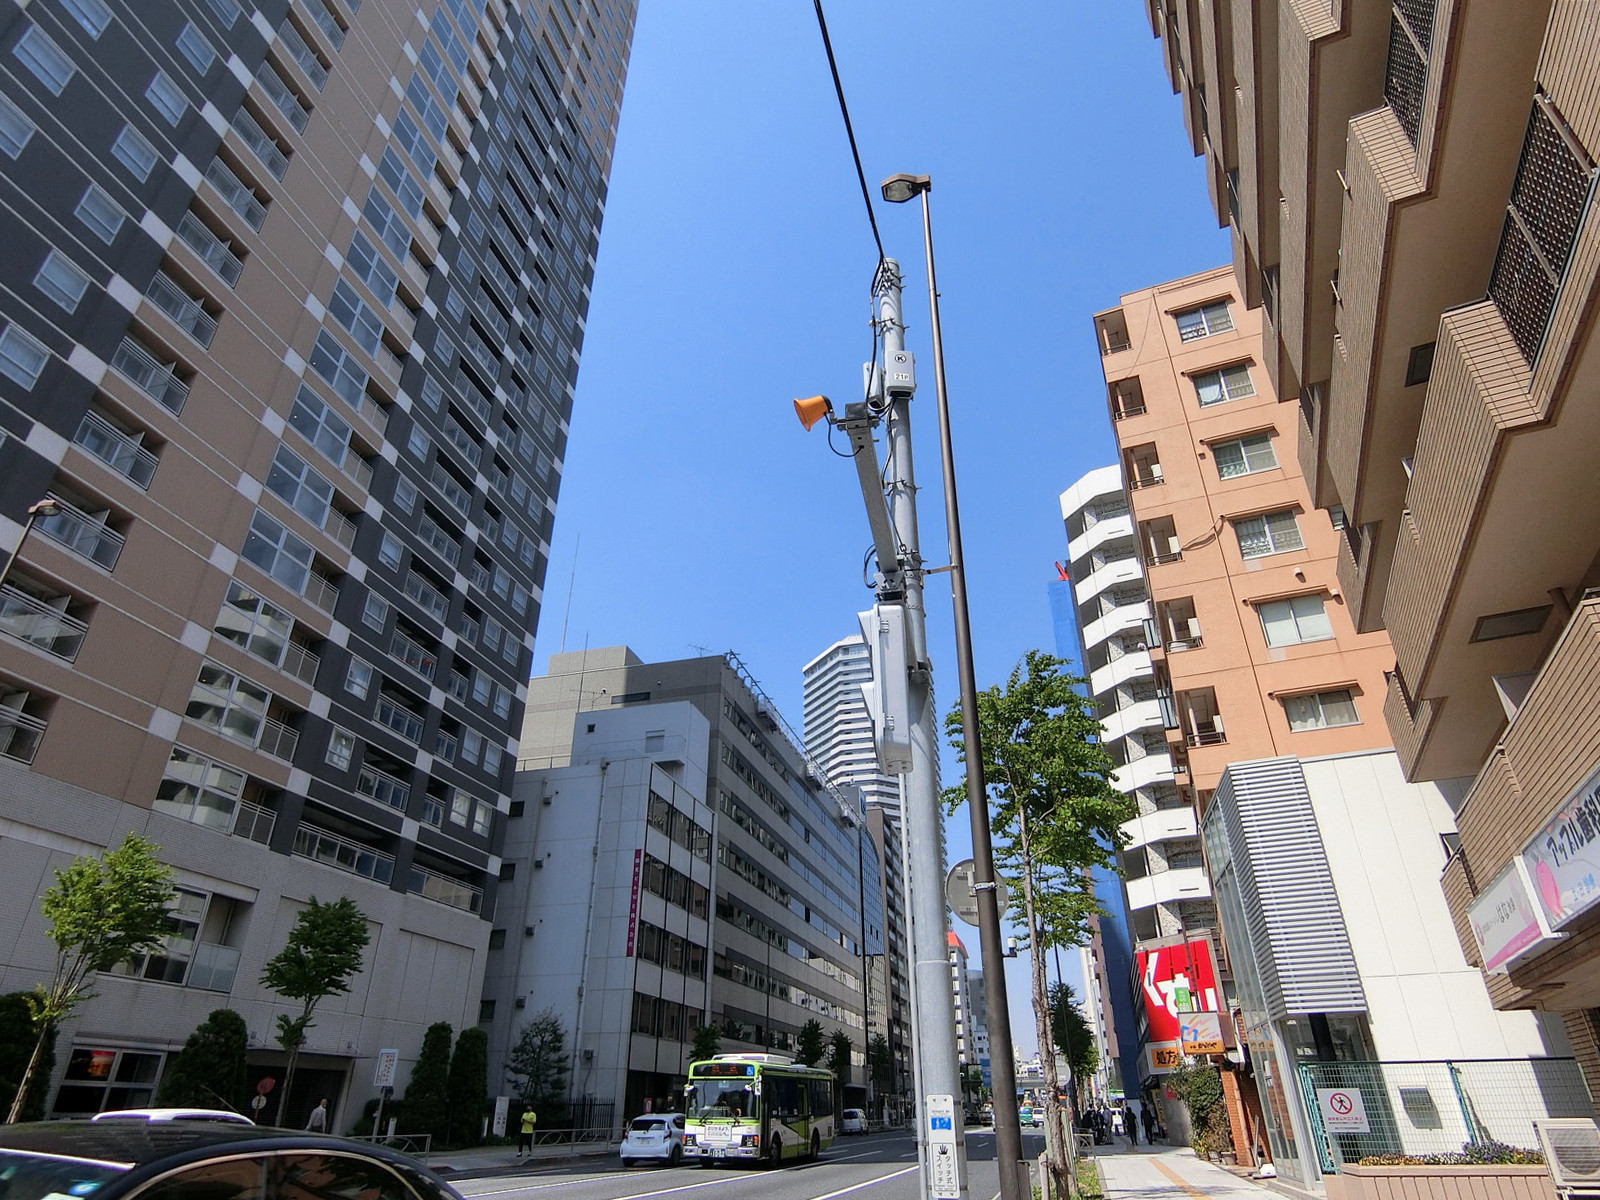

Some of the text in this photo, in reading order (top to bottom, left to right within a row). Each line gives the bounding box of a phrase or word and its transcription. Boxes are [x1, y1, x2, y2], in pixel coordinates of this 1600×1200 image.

[1156, 1050, 1178, 1064] 処方
[945, 1155, 953, 1184] タッチ式
